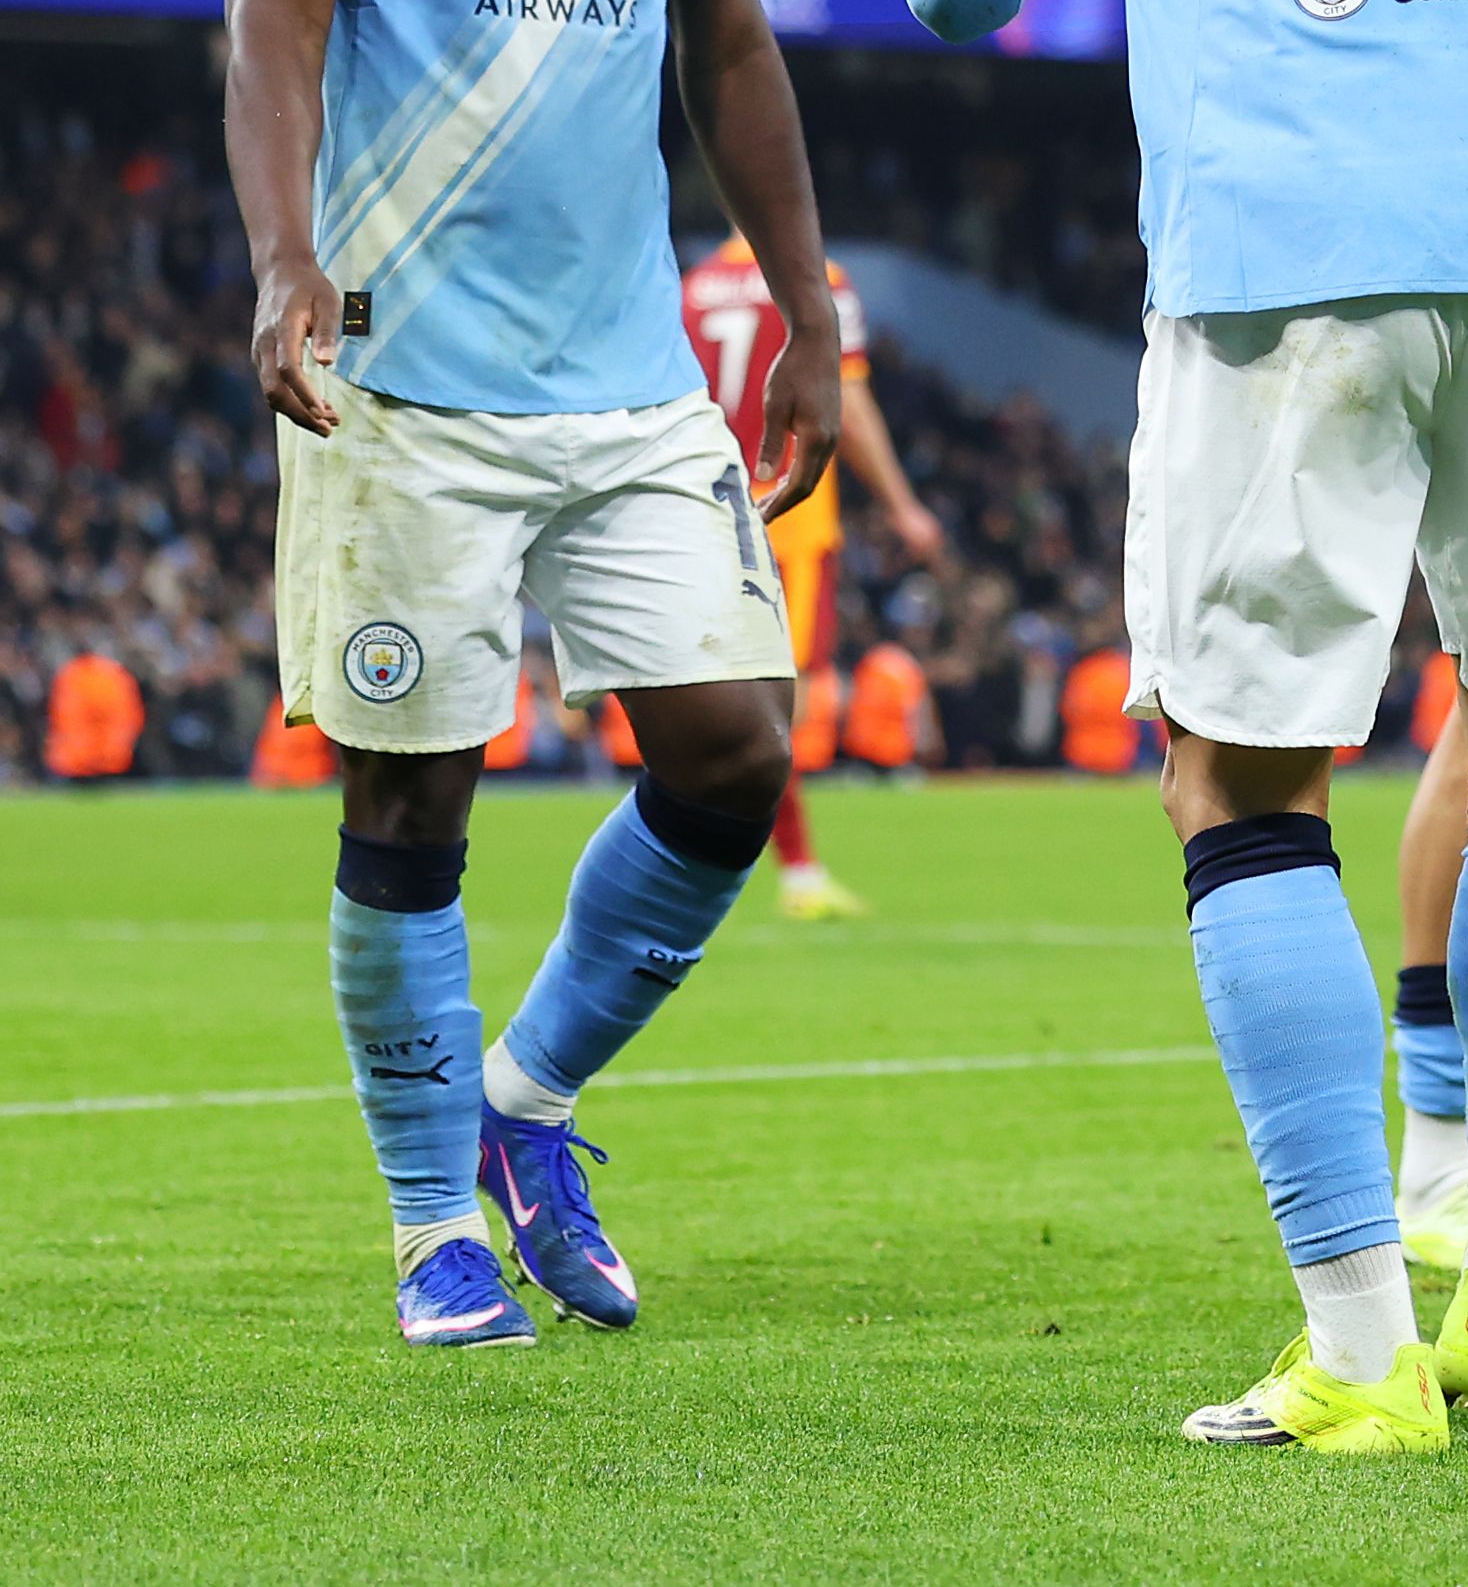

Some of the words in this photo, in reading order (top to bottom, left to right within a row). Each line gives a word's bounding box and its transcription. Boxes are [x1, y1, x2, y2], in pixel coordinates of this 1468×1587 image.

[1323, 5, 1347, 15] CITY
[352, 628, 415, 653] MANCHESTER
[370, 688, 394, 697] CITY
